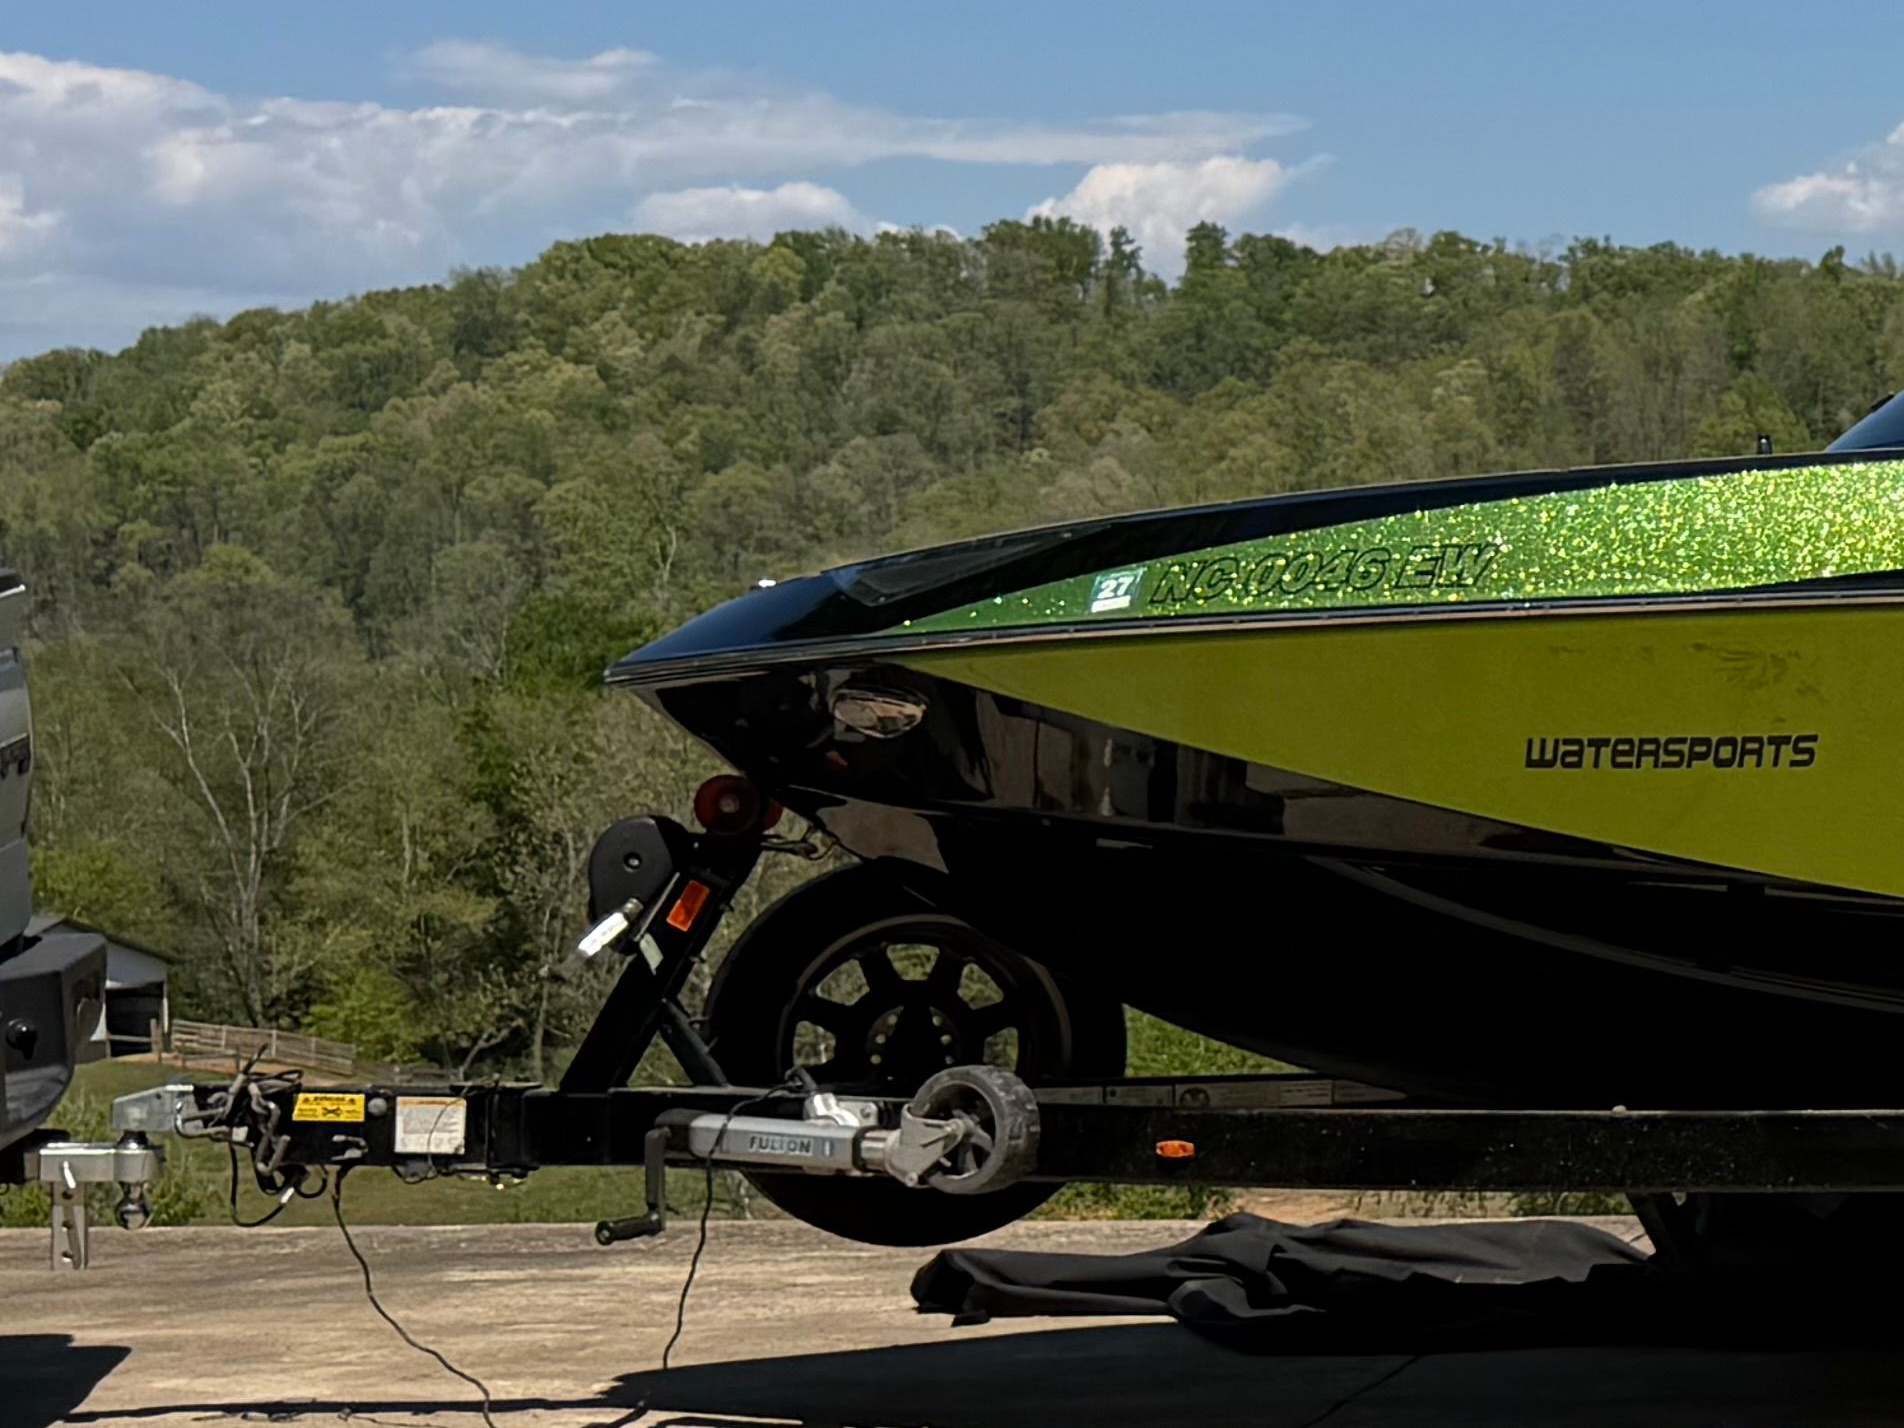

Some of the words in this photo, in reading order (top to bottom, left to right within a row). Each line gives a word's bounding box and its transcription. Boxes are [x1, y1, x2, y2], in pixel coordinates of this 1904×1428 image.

[1097, 576, 1135, 599] 27
[1149, 556, 1238, 604] NC
[1393, 542, 1502, 590] EW
